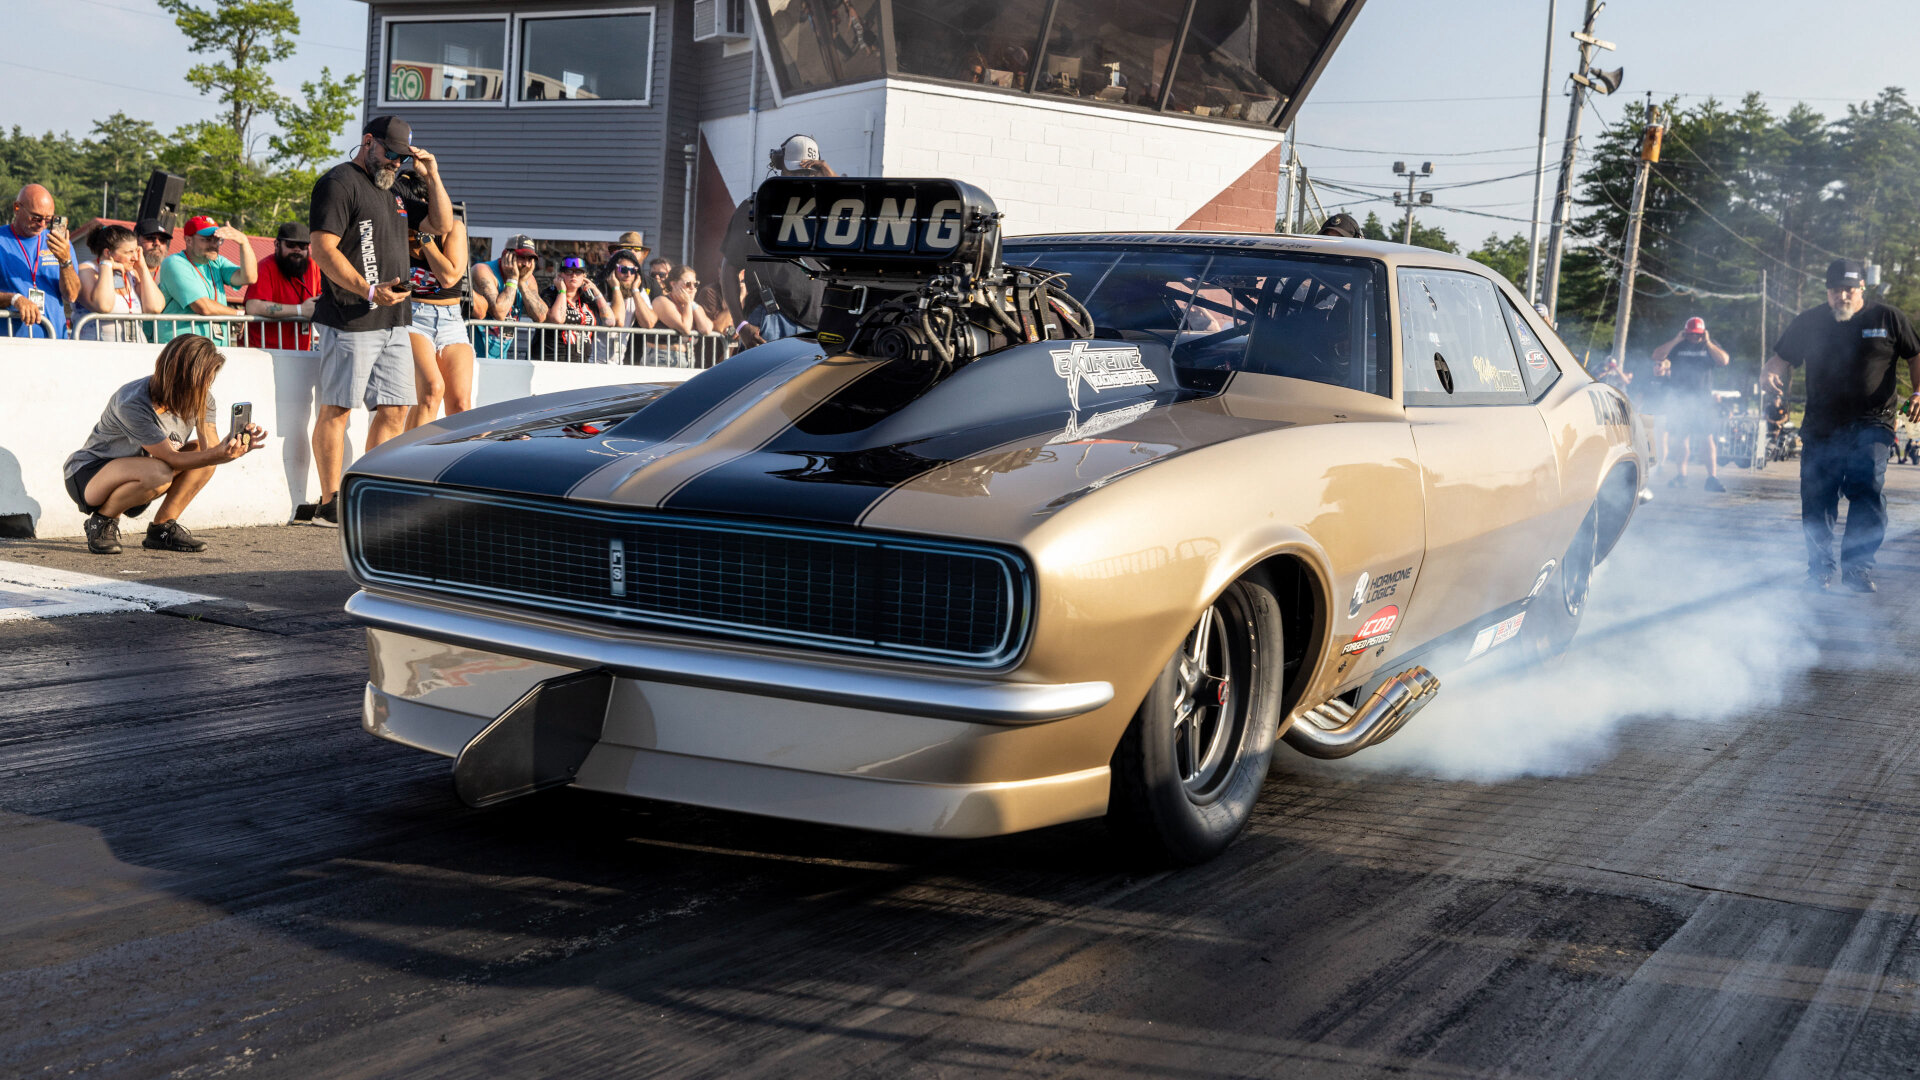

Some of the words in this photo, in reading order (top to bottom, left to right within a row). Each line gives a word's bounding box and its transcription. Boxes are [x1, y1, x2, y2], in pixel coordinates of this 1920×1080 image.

[777, 196, 961, 249] KONG
[359, 219, 380, 286] HORMONELOGIC
[1156, 236, 1260, 246] WHEELS
[1049, 342, 1144, 390] EXTREME
[1370, 567, 1412, 590] HORMONE
[1366, 584, 1397, 604] LOGICS
[1342, 639, 1368, 654] FORGED
[1367, 632, 1393, 646] PISTONS
